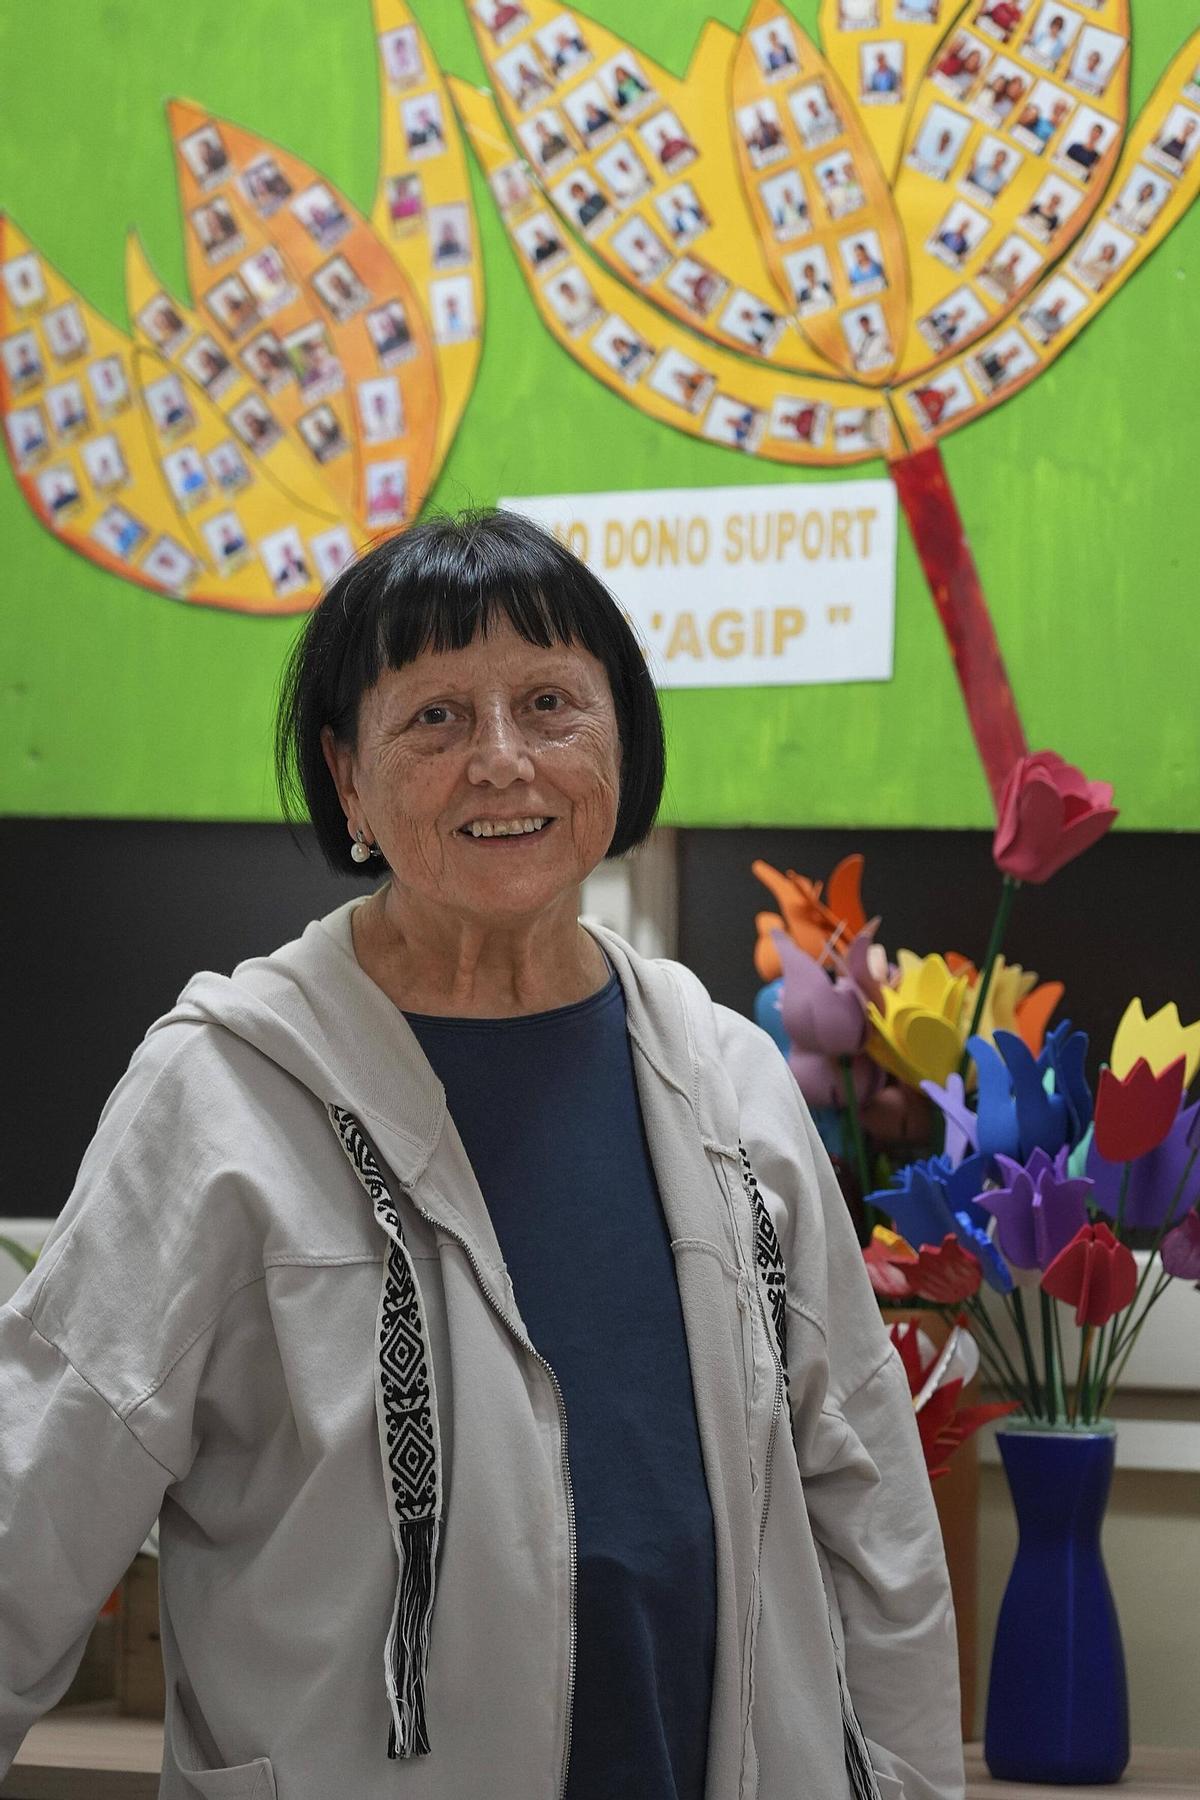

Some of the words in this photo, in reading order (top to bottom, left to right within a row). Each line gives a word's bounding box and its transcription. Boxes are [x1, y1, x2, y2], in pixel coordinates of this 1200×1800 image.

[603, 519, 709, 568] DONO
[724, 508, 879, 564] SUPORT
[624, 606, 806, 660] 'AGIP
